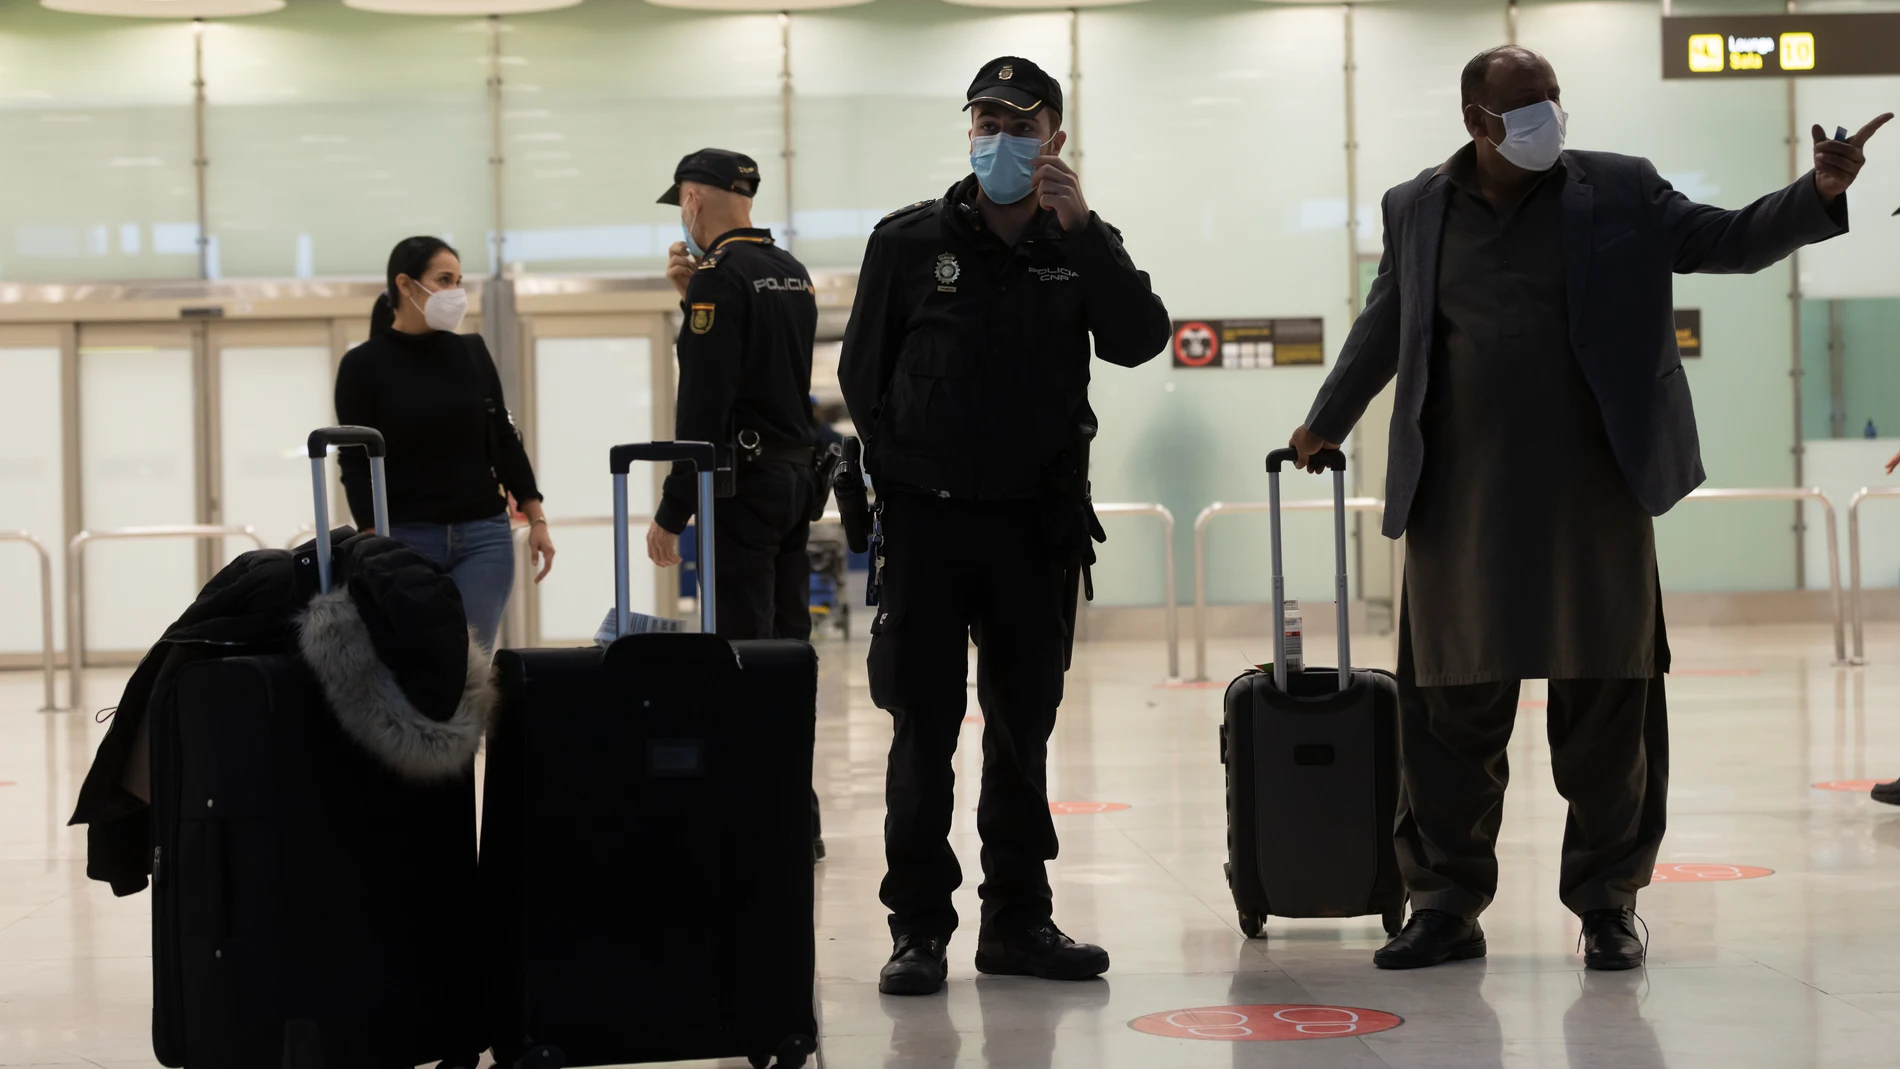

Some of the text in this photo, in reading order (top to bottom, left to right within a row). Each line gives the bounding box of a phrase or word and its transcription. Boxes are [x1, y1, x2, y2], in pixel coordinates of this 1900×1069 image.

[1784, 39, 1811, 63] 10
[1028, 266, 1080, 277] POLICIA
[752, 277, 810, 293] POLICIA
